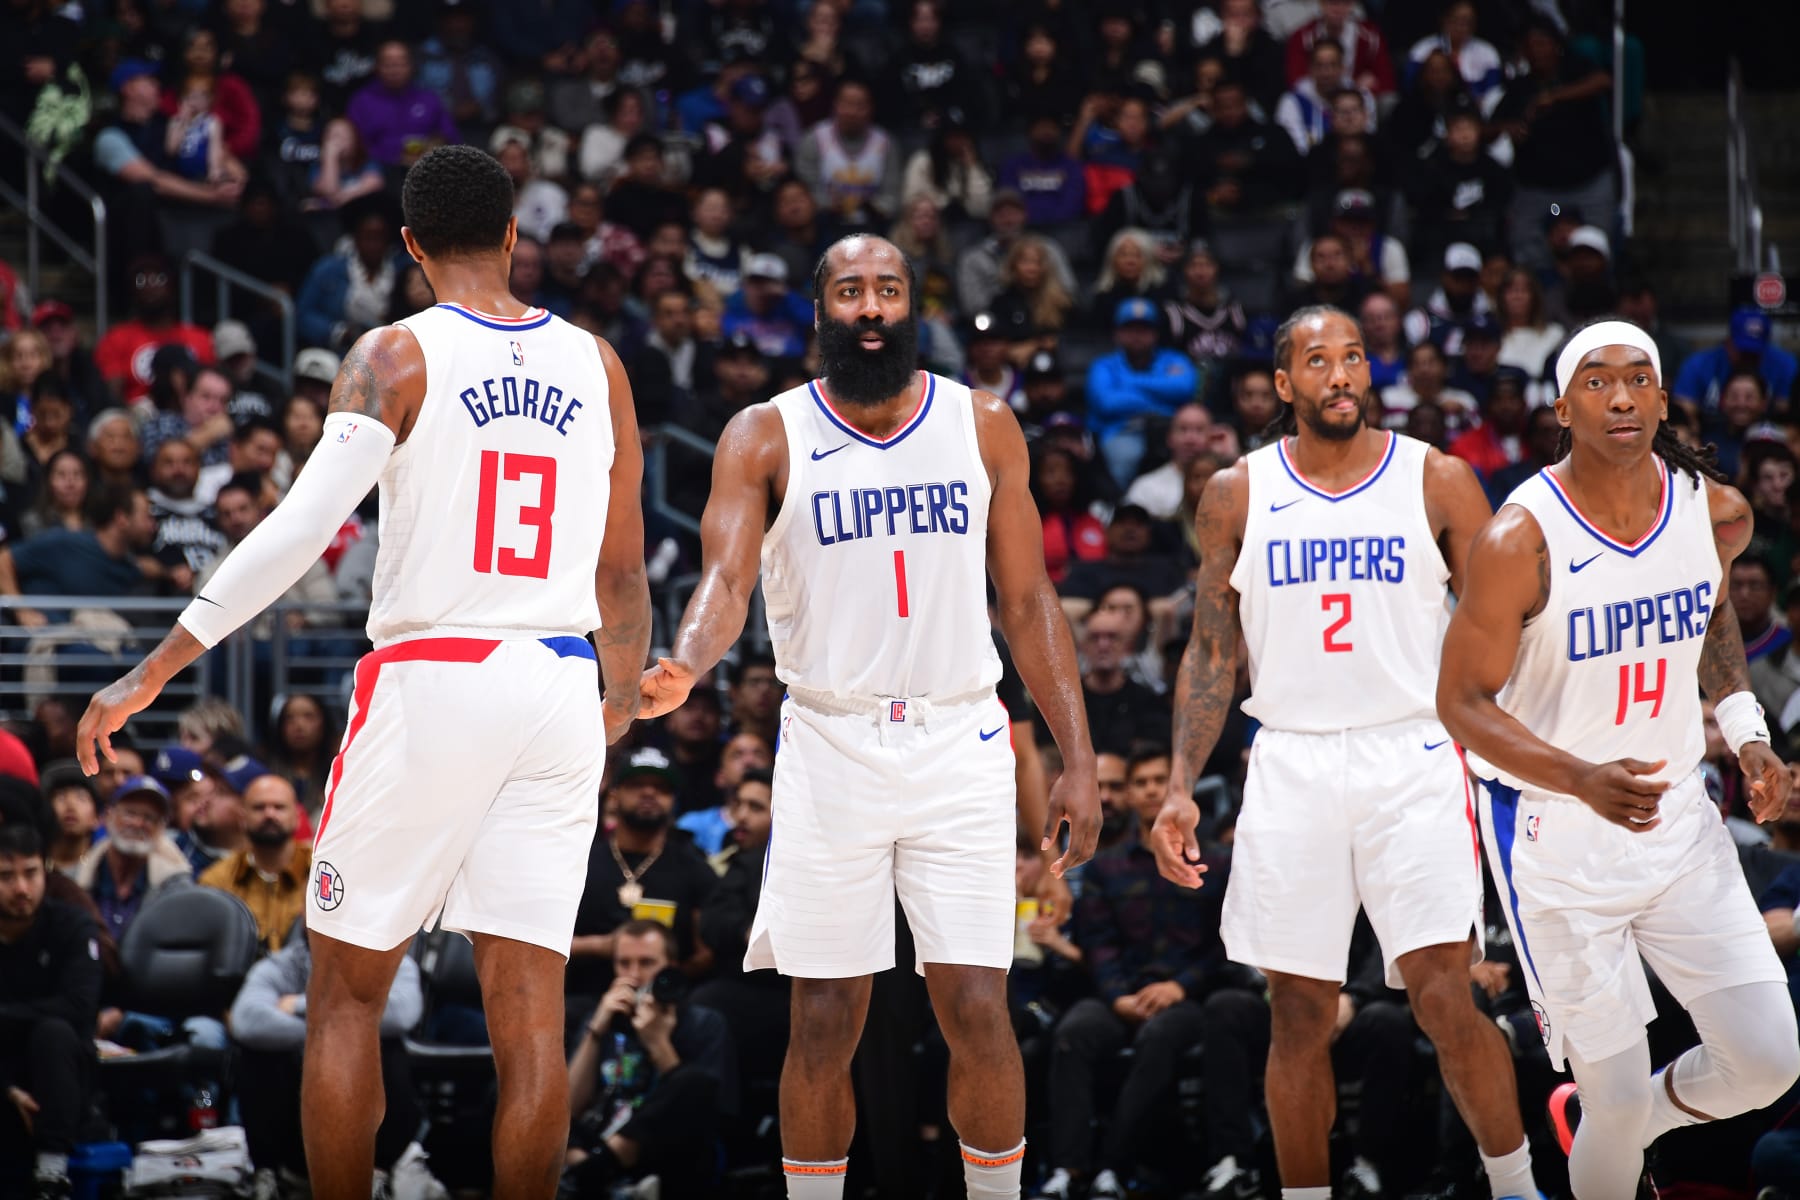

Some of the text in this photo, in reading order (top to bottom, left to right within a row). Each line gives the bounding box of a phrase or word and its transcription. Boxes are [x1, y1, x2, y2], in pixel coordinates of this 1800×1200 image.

[460, 377, 583, 436] GEORGE
[473, 450, 557, 580] 13
[812, 482, 969, 546] CLIPPERS
[893, 550, 909, 618] 1
[1267, 536, 1405, 588] CLIPPERS
[1321, 593, 1353, 653] 2
[1567, 582, 1711, 663] CLIPPERS
[1615, 658, 1667, 726] 14
